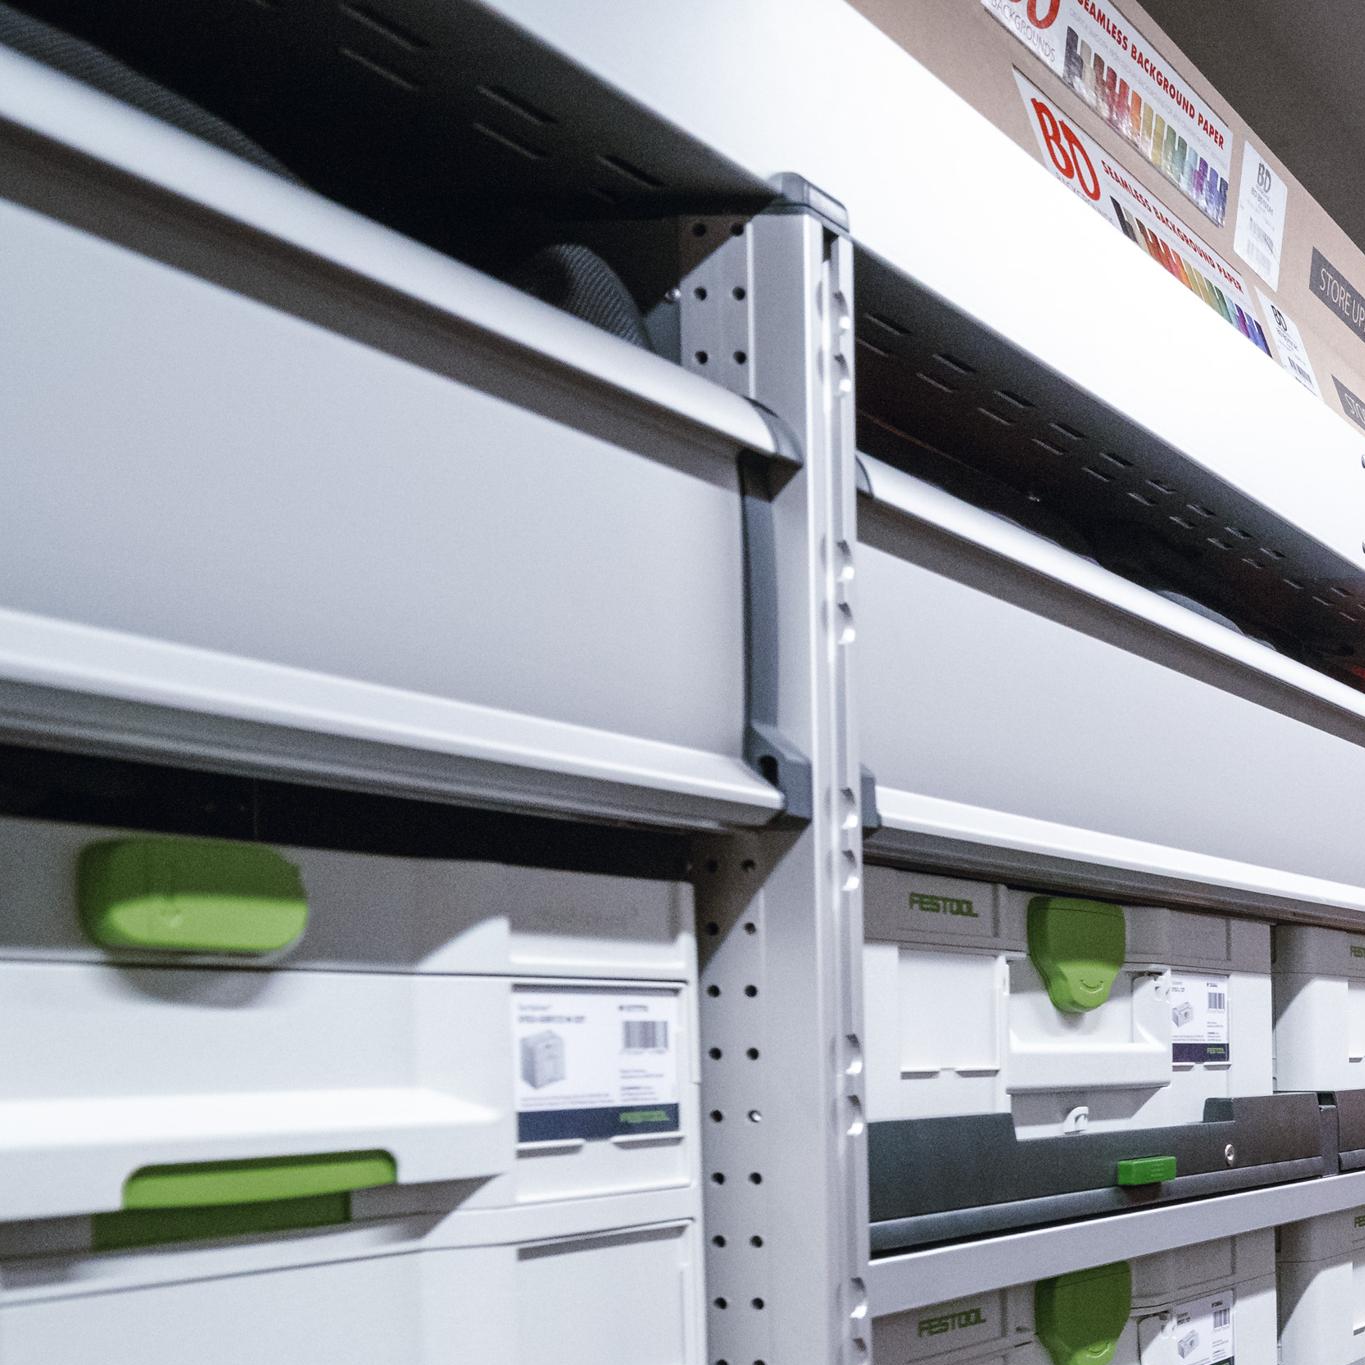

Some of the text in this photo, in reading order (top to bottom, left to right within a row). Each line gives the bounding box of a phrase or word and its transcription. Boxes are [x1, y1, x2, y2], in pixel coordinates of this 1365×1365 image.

[1131, 43, 1196, 120] BACKGROUND
[1197, 110, 1225, 150] PAPER
[1031, 98, 1100, 201] BD
[1101, 159, 1152, 212] SEAMLESS
[1256, 162, 1272, 194] BD
[1319, 268, 1350, 316] STORE
[909, 892, 978, 918] FESTOOL
[918, 1307, 986, 1338] FESTOOL
